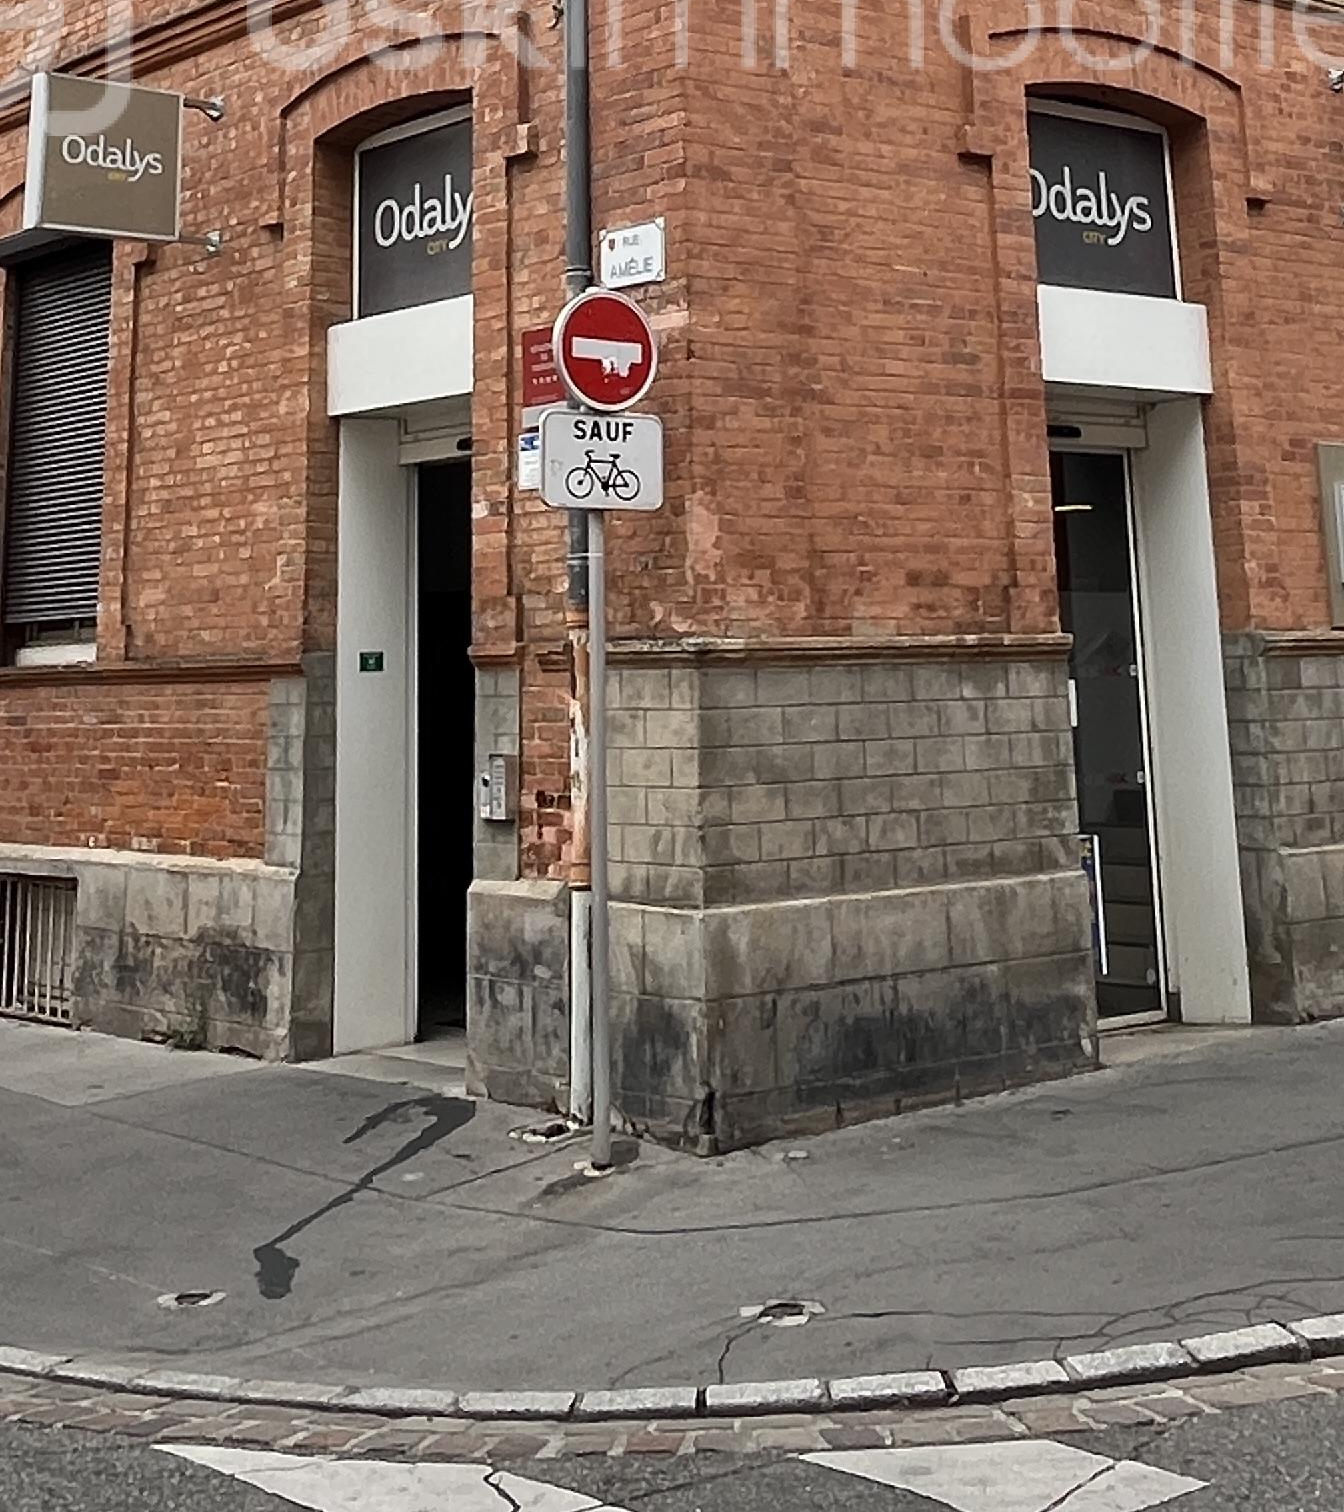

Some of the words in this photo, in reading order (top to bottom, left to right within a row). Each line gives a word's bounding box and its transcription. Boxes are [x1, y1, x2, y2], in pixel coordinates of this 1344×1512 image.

[61, 134, 164, 182] Odalys
[374, 173, 474, 250] Odaly
[622, 234, 641, 247] RUE
[572, 418, 635, 443] SAUF
